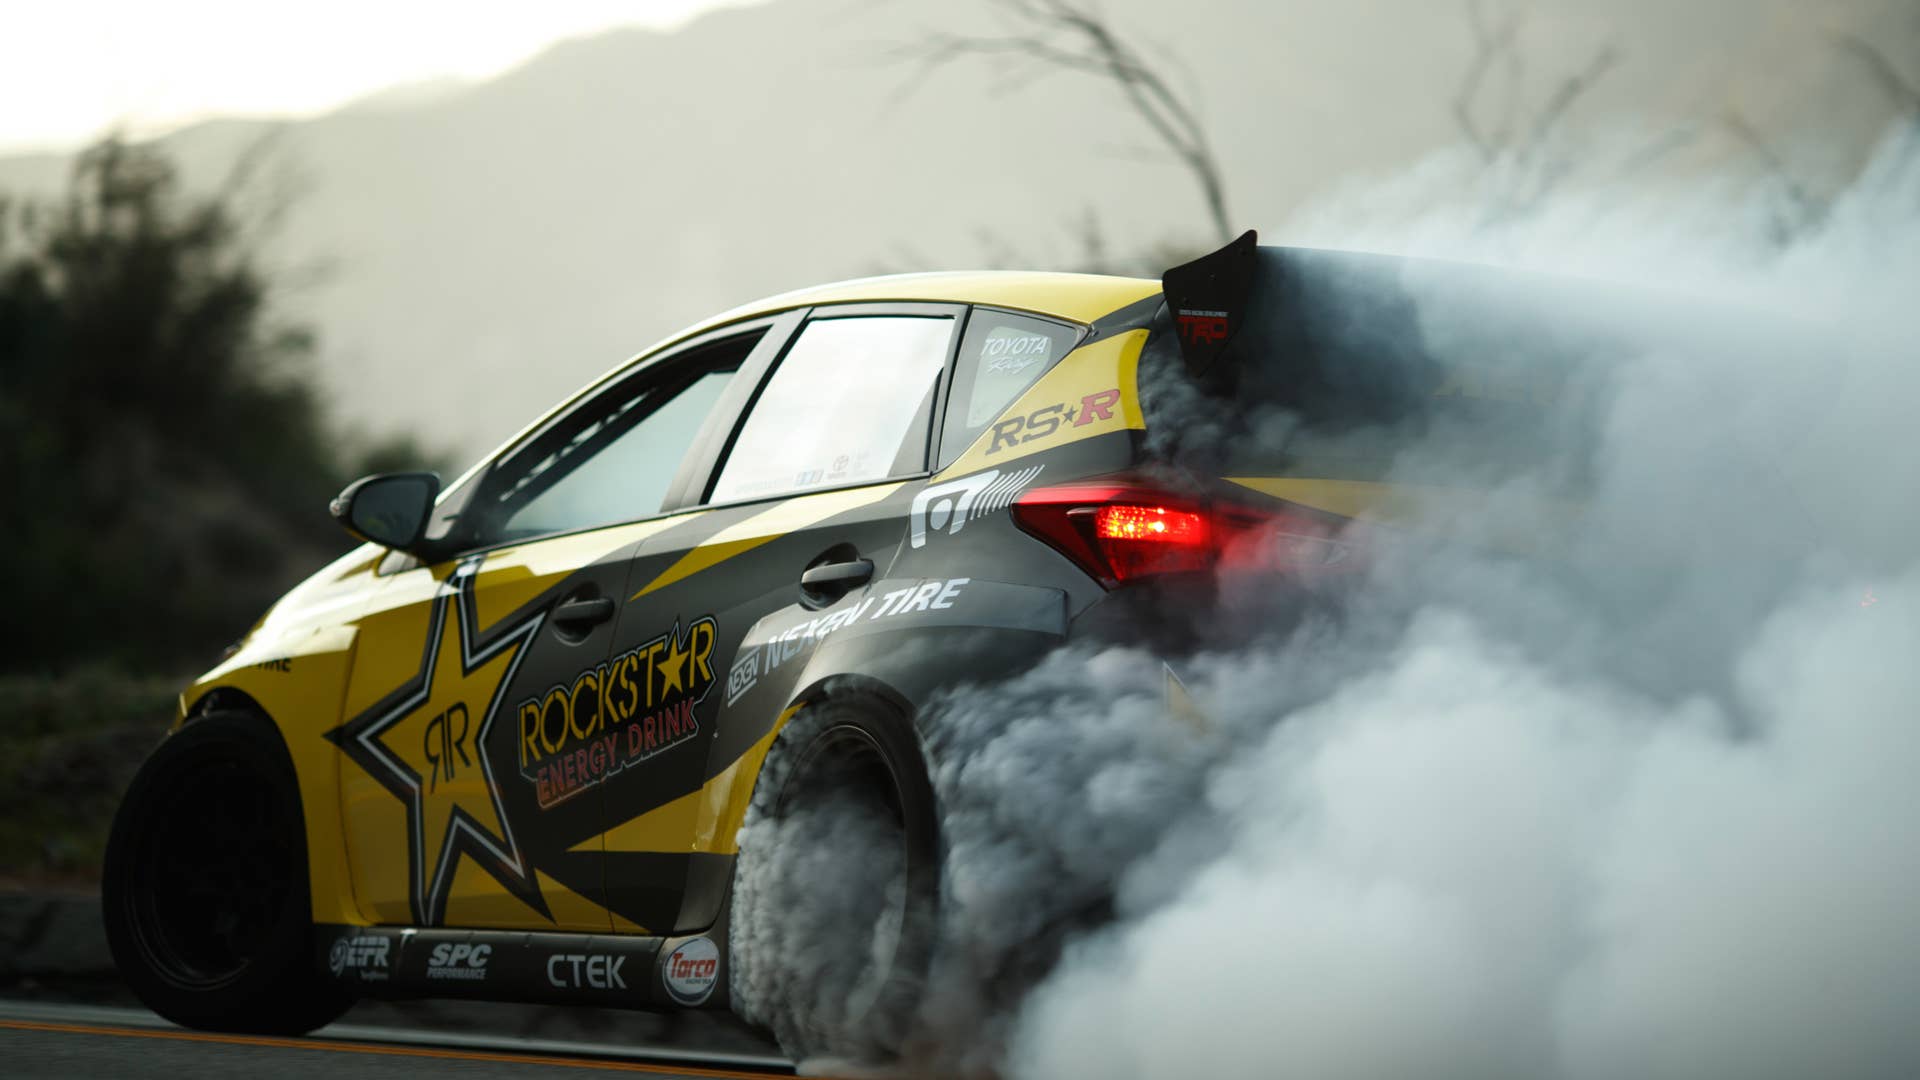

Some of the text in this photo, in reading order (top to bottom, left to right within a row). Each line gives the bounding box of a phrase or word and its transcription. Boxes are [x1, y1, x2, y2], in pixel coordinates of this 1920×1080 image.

[1178, 316, 1228, 344] TRD
[980, 336, 1049, 356] TOYOTA
[764, 577, 971, 674] NEXEN TIRE
[537, 696, 696, 798] ENERGY DRINK
[428, 943, 492, 968] SPC
[671, 952, 716, 979] Torco
[547, 954, 627, 989] CTEK
